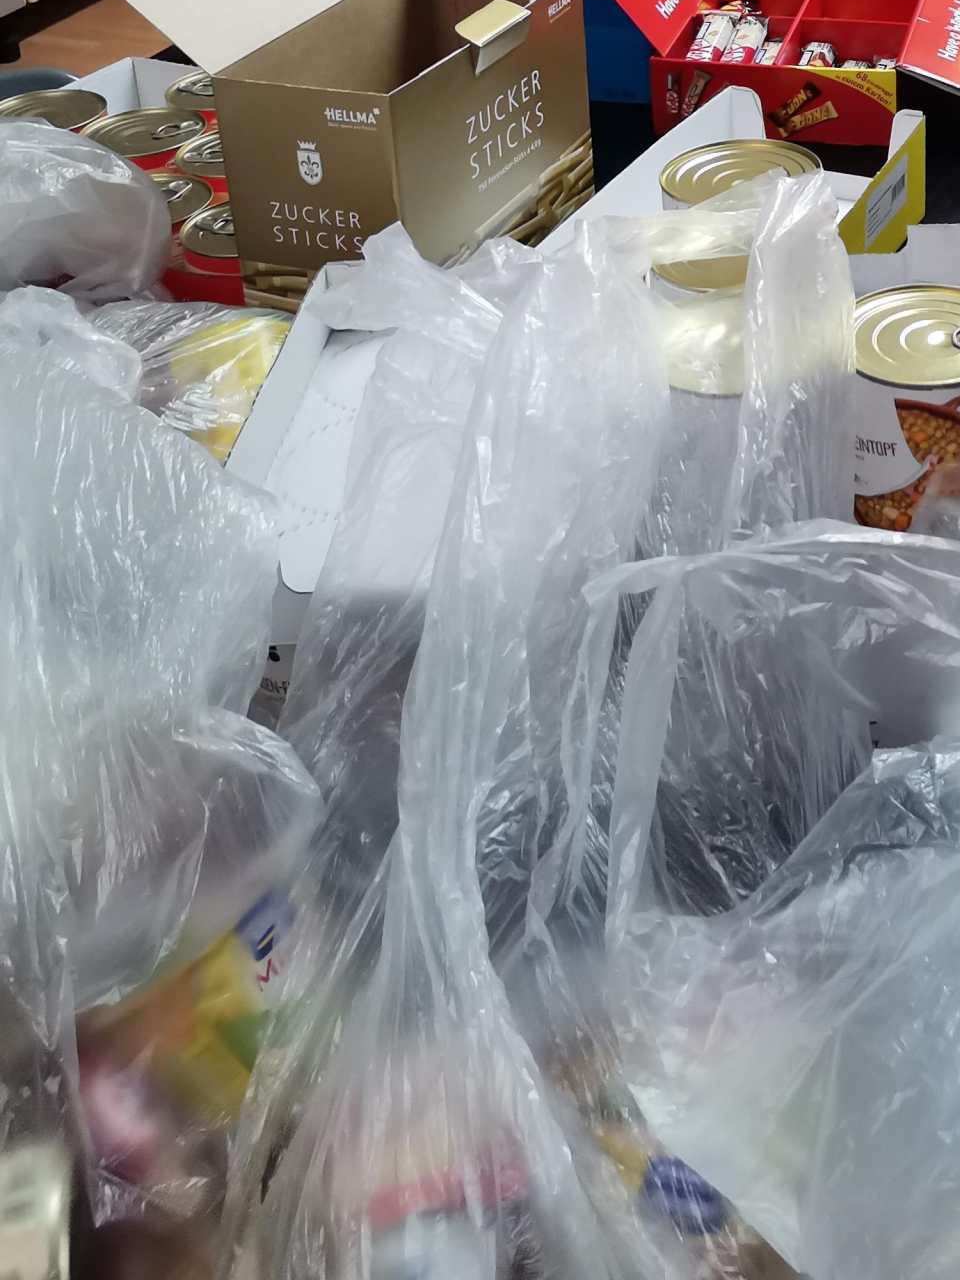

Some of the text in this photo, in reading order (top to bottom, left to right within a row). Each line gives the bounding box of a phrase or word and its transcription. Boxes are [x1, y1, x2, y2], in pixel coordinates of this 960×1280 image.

[324, 107, 377, 124] HELLMA
[465, 70, 541, 144] ZUCKER
[469, 101, 544, 179] STICKS
[269, 201, 361, 229] ZUCKER
[272, 225, 364, 253] STICKS
